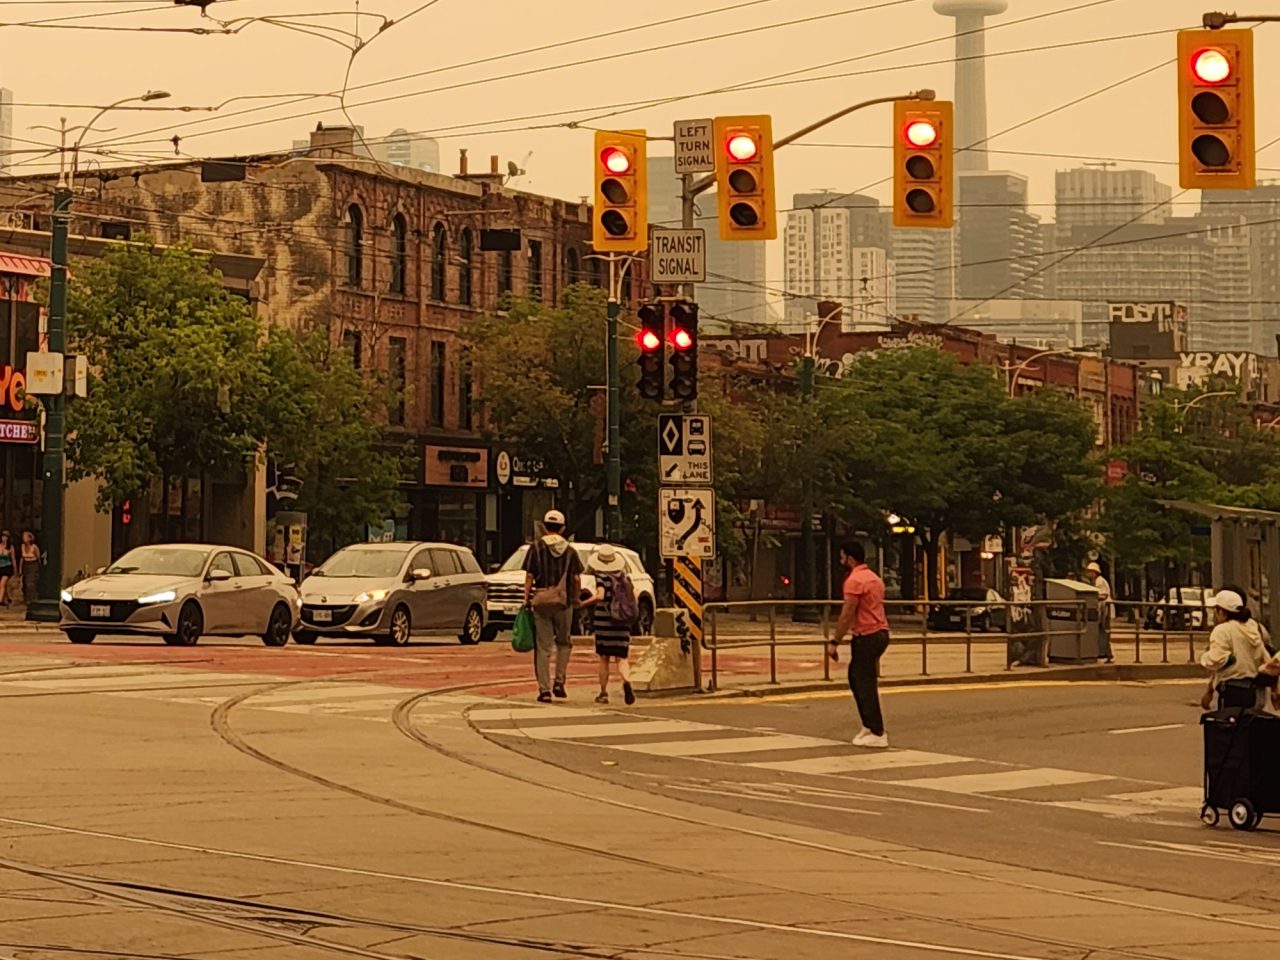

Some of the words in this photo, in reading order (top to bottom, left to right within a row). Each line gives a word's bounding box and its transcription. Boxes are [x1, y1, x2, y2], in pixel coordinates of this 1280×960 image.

[680, 126, 707, 138] LEFT
[679, 140, 710, 152] TURN
[677, 155, 713, 167] SIGNAL
[655, 236, 702, 254] TRANSIT
[658, 258, 699, 275] SIGNAL
[687, 461, 709, 470] THIS
[682, 471, 709, 480] LANE
